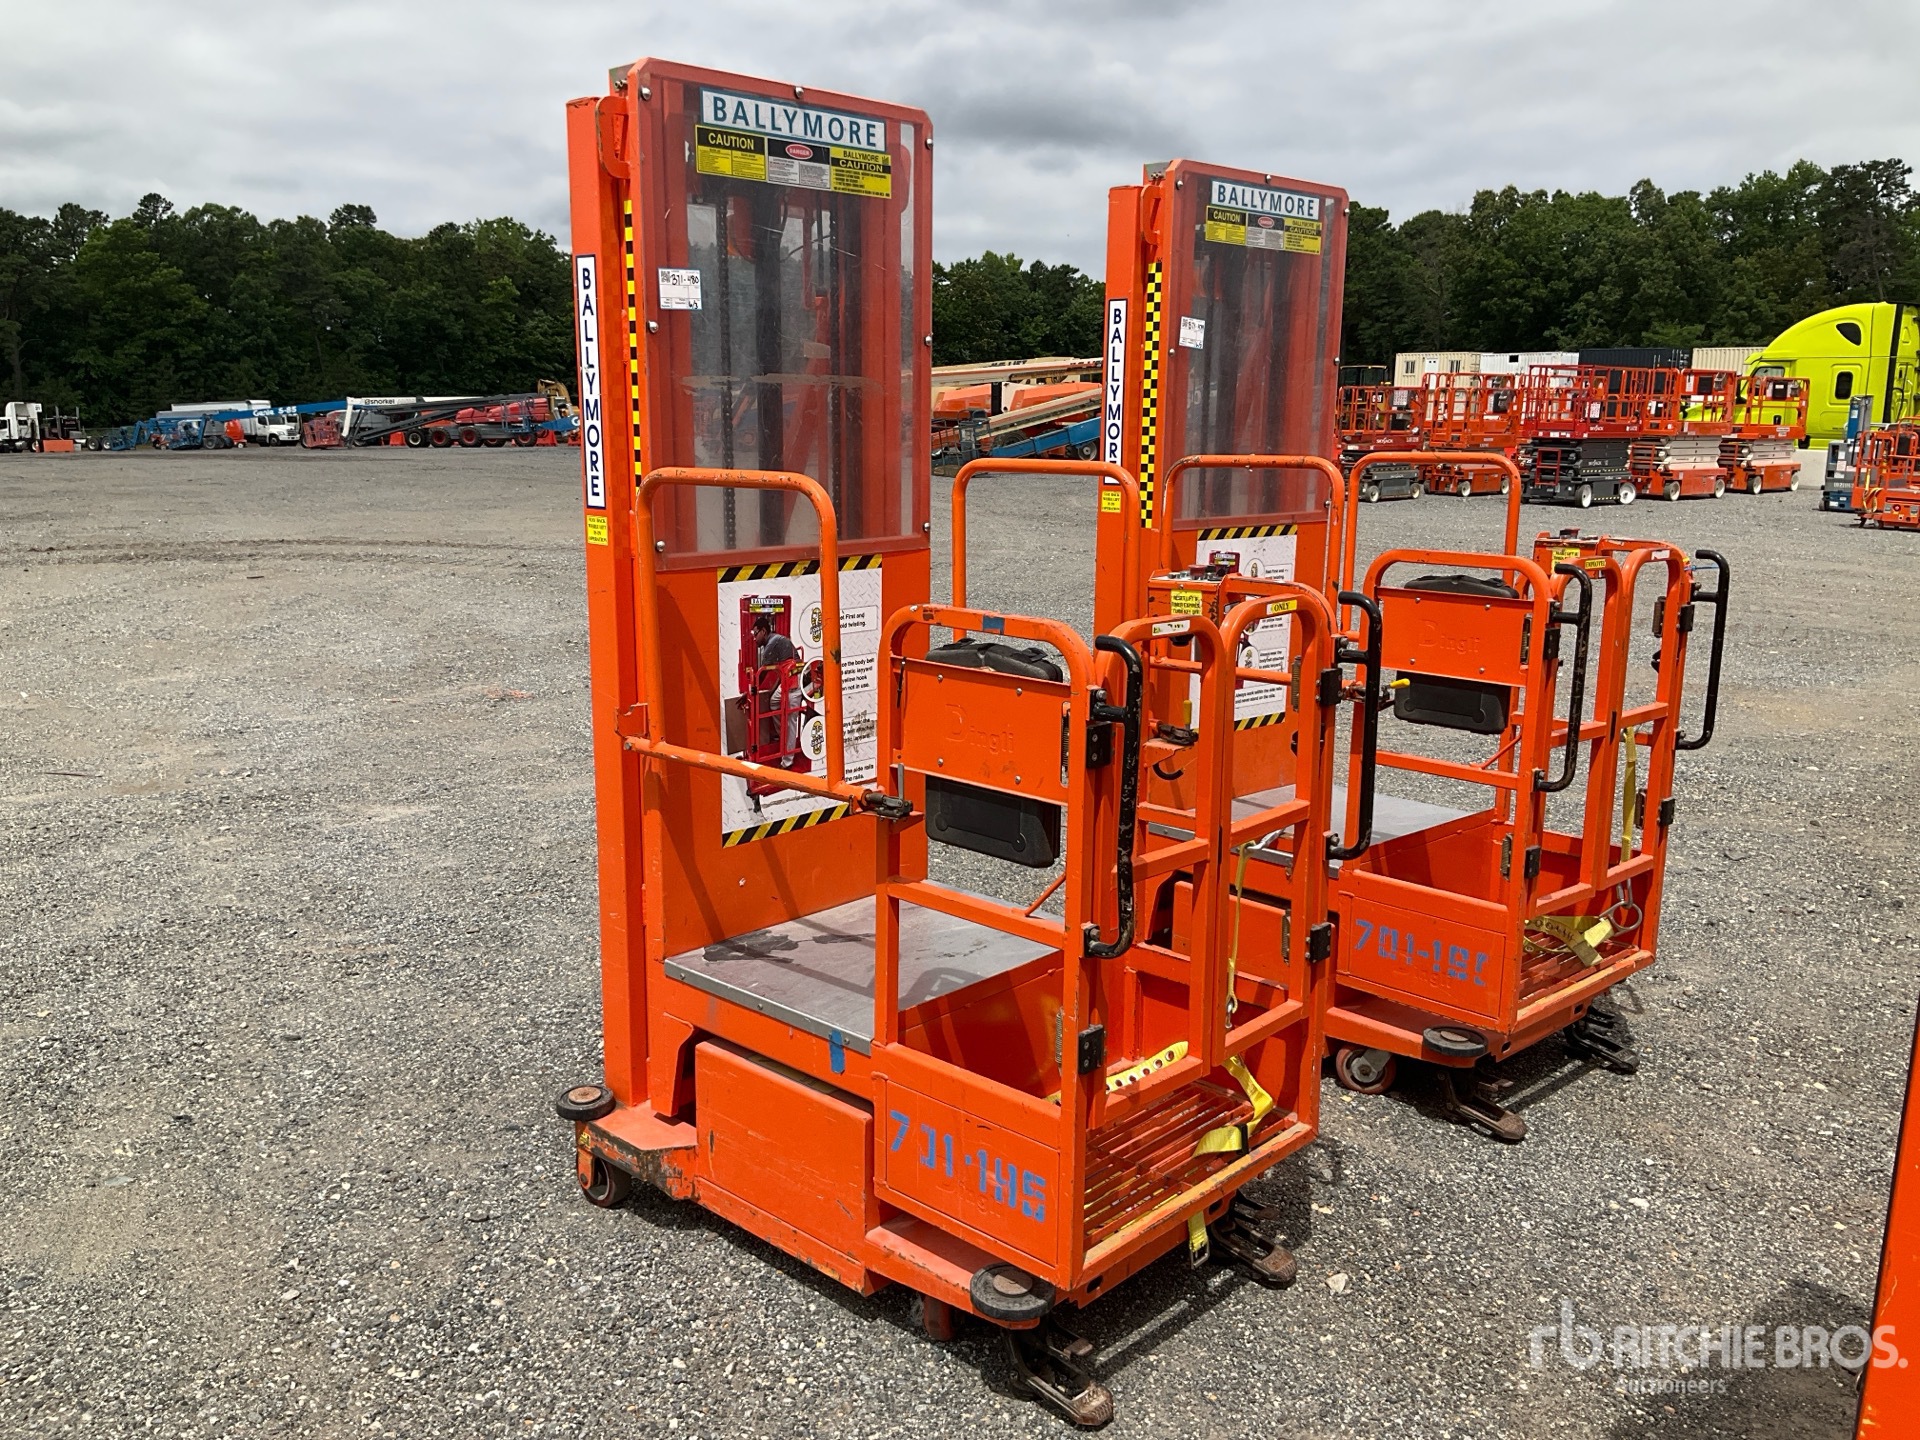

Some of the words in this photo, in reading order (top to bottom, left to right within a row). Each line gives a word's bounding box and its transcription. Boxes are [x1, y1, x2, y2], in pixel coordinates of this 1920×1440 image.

[713, 96, 876, 147] BALLYMORE
[708, 132, 755, 150] CAUTION
[789, 148, 810, 156] DANGER
[843, 150, 879, 162] BALLYMORE
[840, 160, 882, 172] CAUTION
[1217, 184, 1314, 217] BALLYMORE
[1213, 210, 1240, 222] CAUTION
[1289, 226, 1316, 236] CAUTION
[582, 267, 600, 497] BALLYMORE
[1108, 308, 1122, 464] BALLYMOR
[278, 406, 297, 414] S-85
[1274, 603, 1289, 611] ONLY
[1418, 618, 1481, 655] Dingli
[855, 658, 865, 667] body
[945, 702, 1014, 756] Dingli
